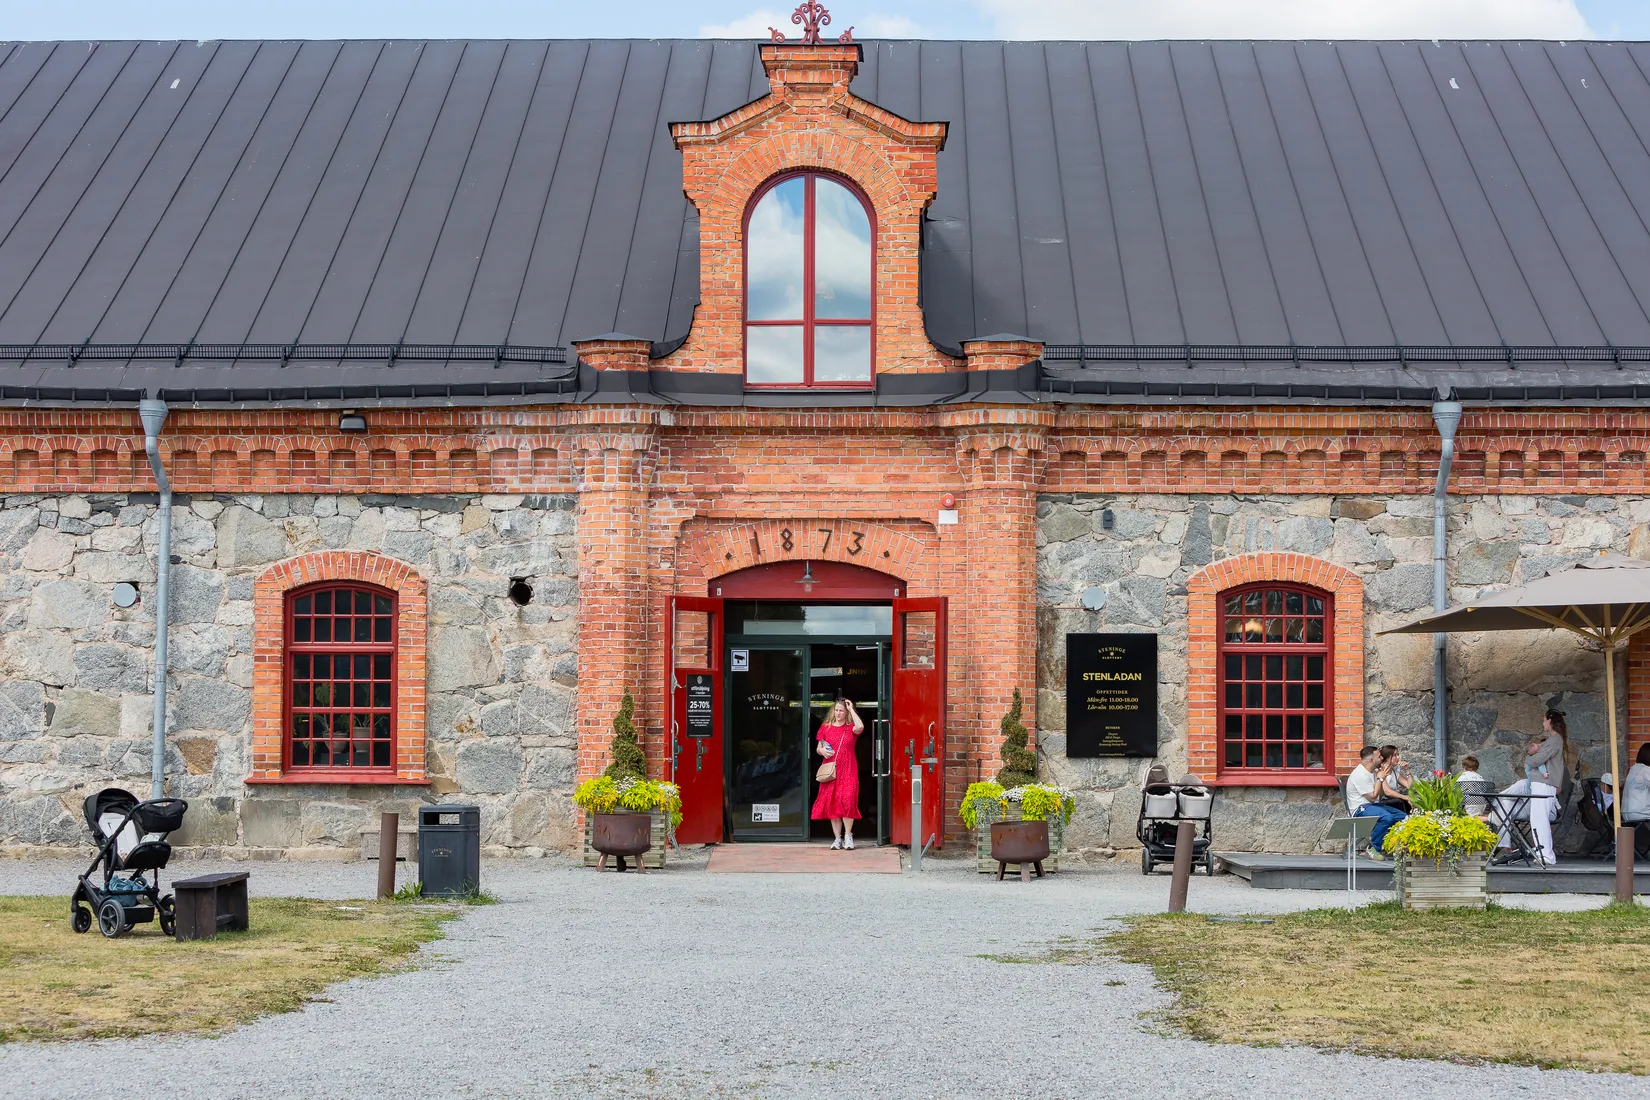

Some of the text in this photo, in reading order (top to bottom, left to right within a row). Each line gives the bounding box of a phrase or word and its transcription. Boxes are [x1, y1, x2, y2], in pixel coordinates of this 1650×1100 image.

[754, 528, 865, 556] 1873
[1097, 646, 1126, 654] STENINGE
[1082, 672, 1142, 681] STENLADAN
[747, 693, 785, 702] STENINGE
[689, 701, 711, 709] 25-70%
